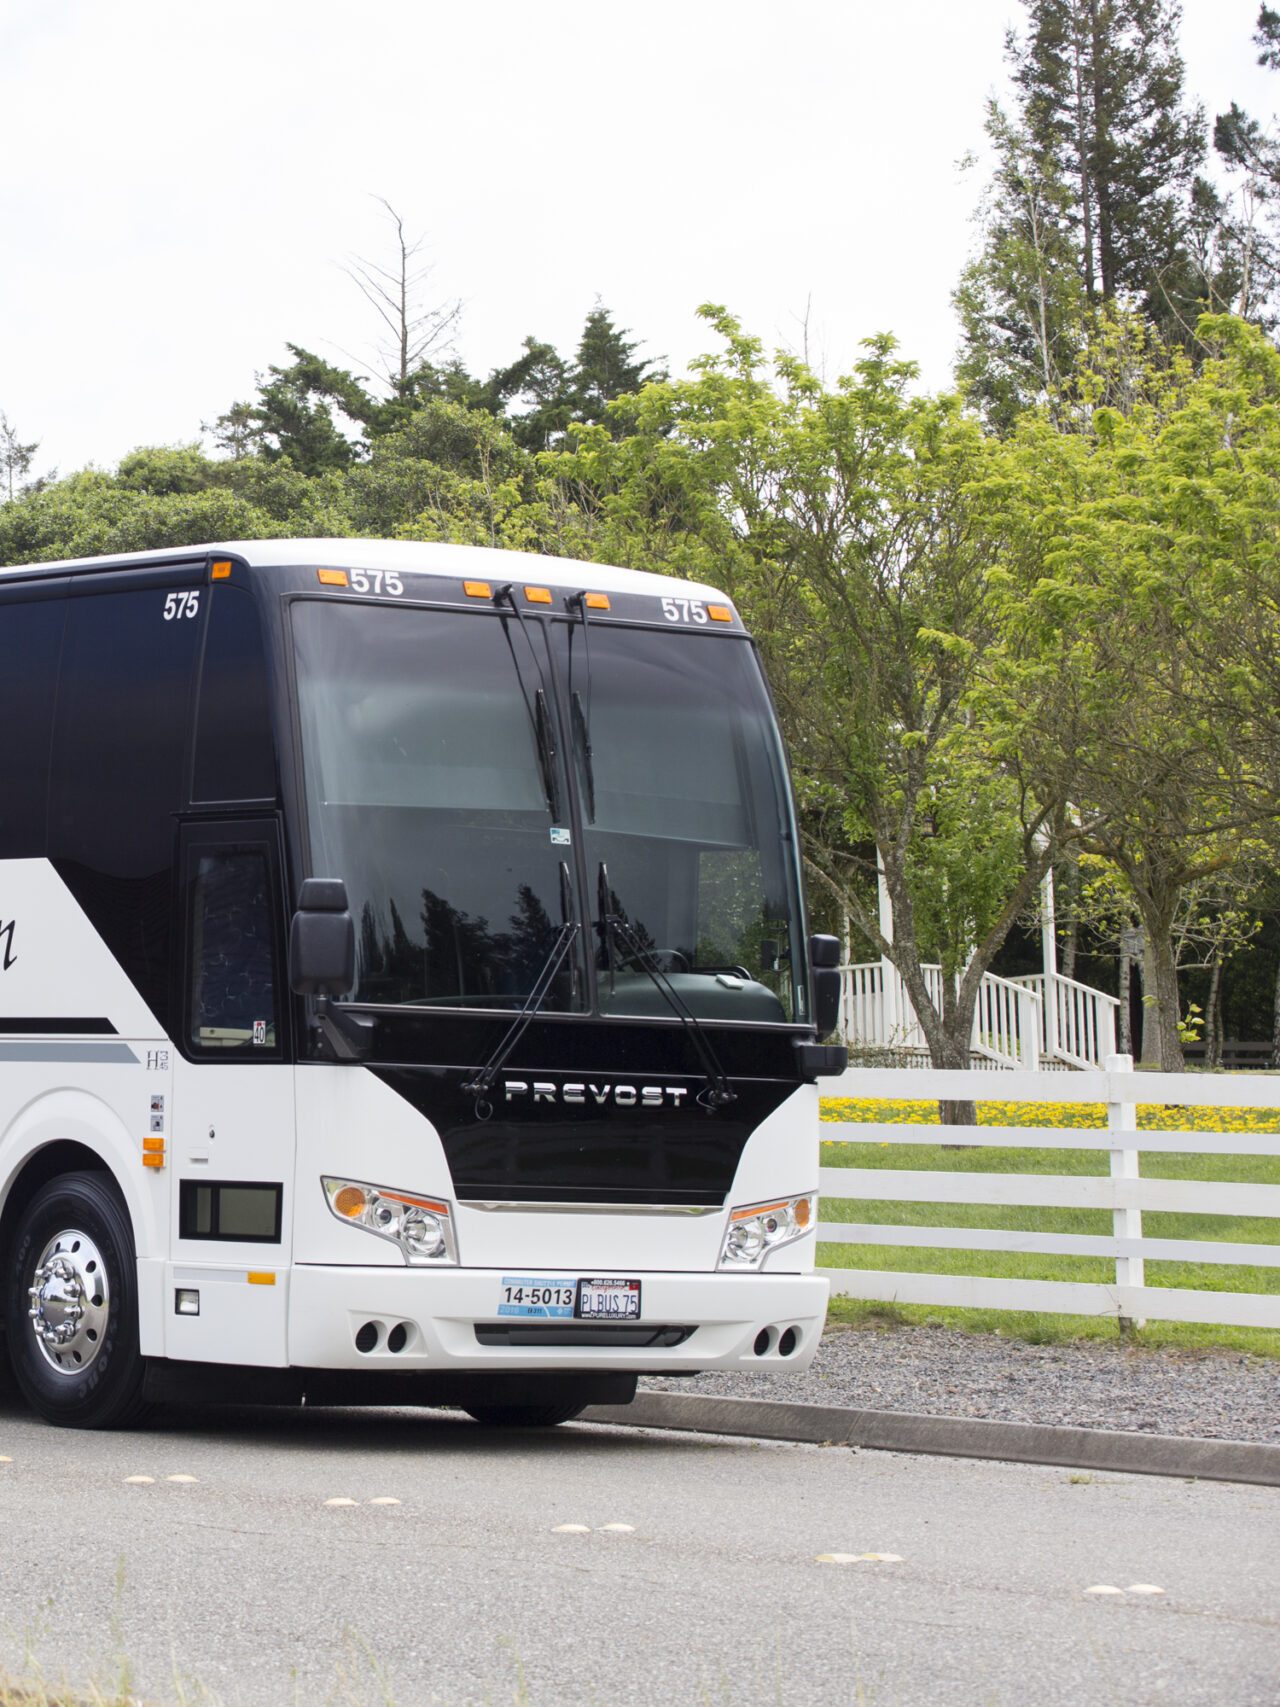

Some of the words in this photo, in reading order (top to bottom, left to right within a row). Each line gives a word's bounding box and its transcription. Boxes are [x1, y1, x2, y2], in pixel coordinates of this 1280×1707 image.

[350, 568, 404, 596] 575
[163, 590, 200, 621] 575
[660, 597, 708, 624] 575
[254, 1026, 265, 1043] 40
[504, 1080, 688, 1107] PREVOST
[504, 1286, 573, 1306] 14-5013
